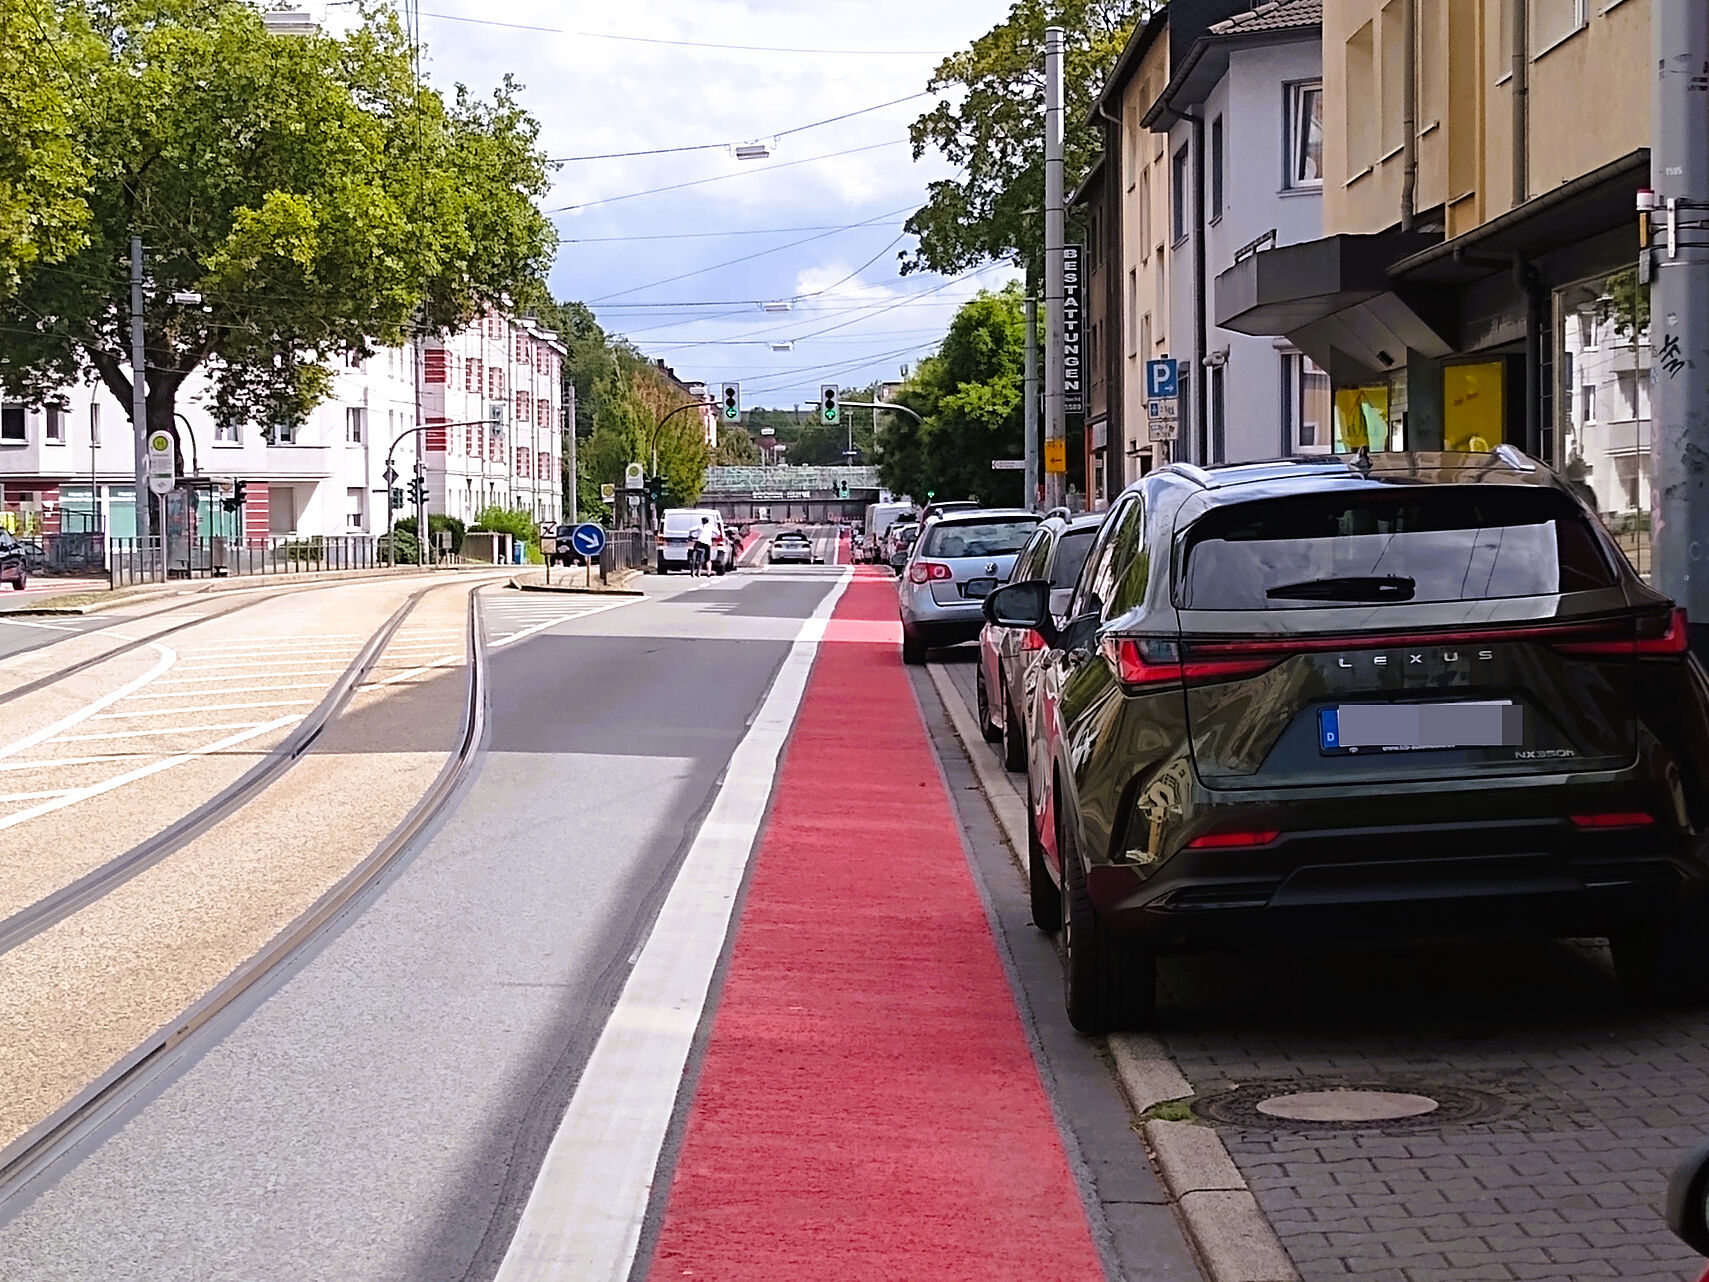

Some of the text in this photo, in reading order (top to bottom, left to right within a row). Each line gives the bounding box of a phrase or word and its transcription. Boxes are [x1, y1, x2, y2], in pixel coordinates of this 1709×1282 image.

[1063, 248, 1080, 391] BESTATTUNGEN
[1153, 364, 1171, 394] P
[1338, 650, 1494, 669] LEXUS
[1326, 732, 1335, 742] D
[1514, 748, 1576, 759] NX350h
